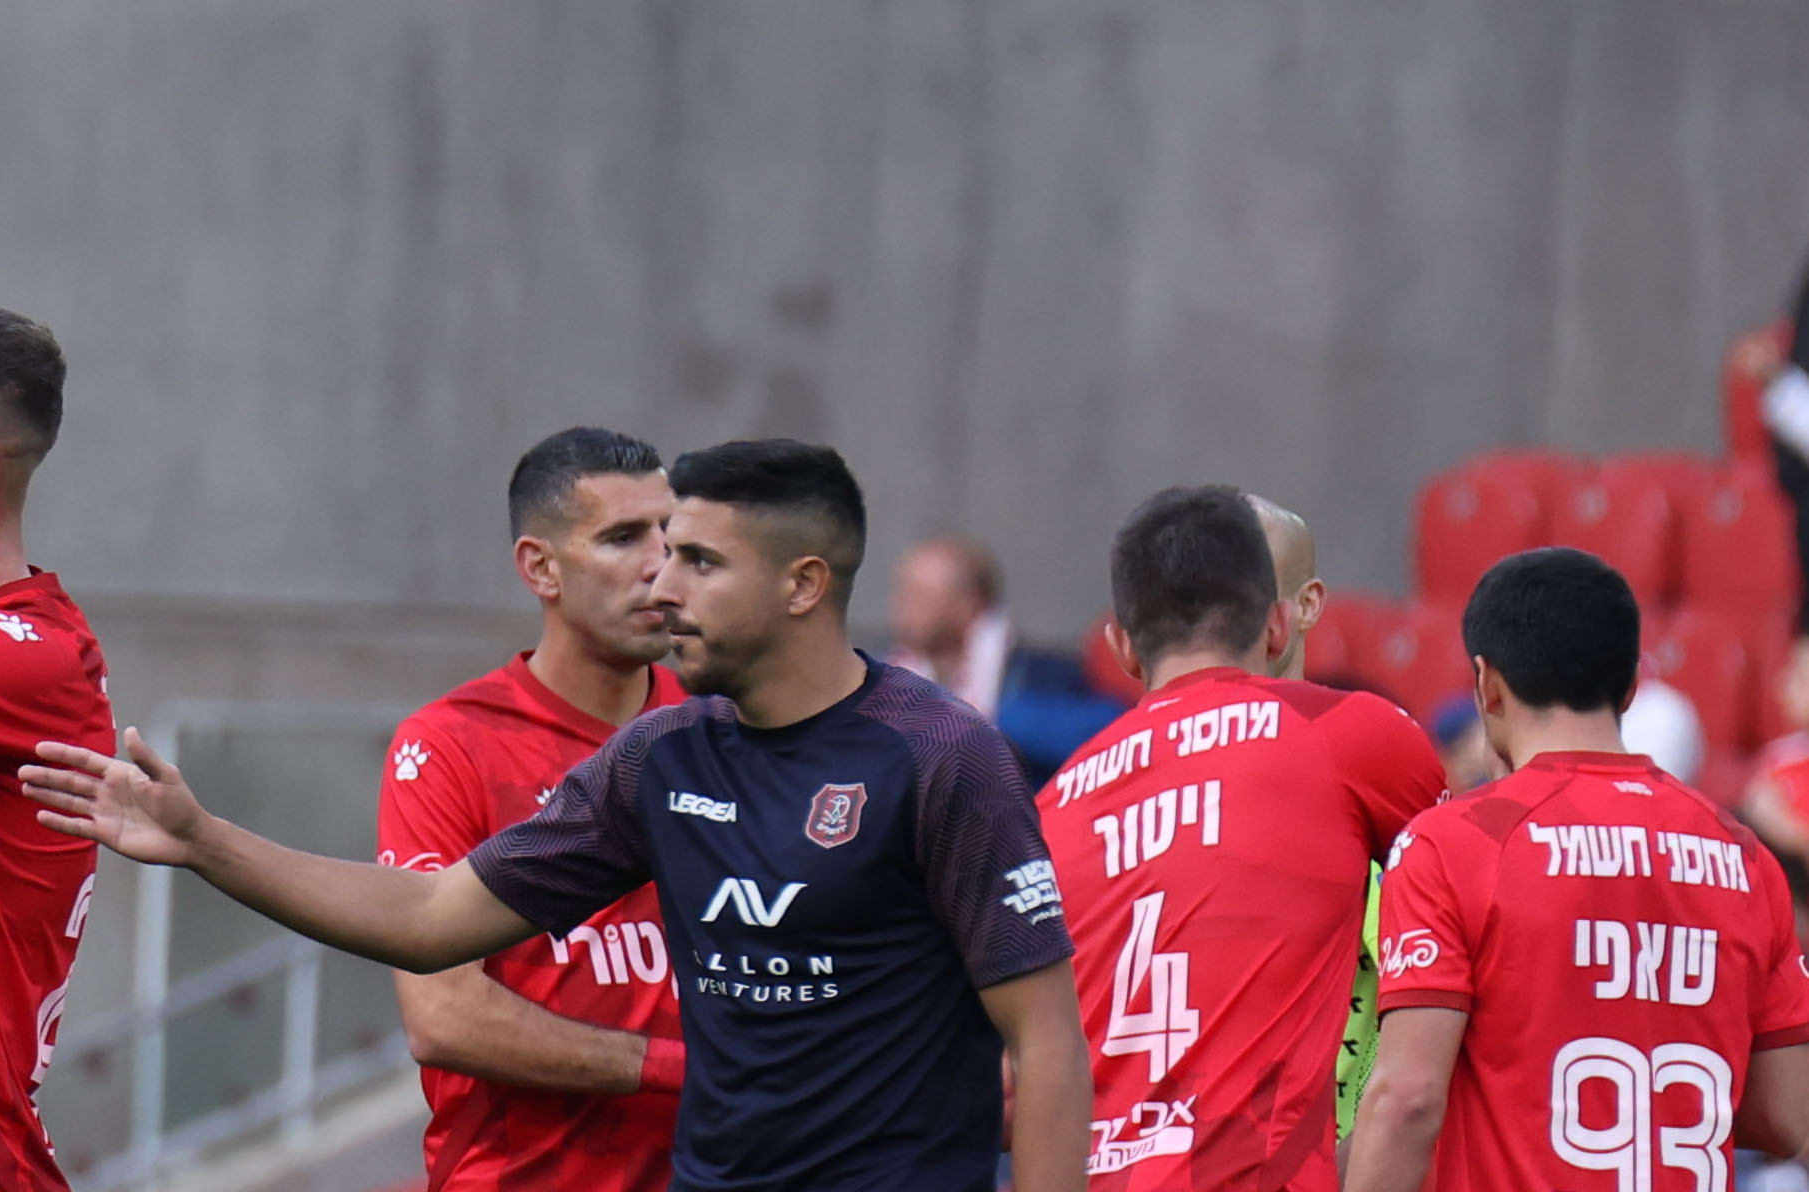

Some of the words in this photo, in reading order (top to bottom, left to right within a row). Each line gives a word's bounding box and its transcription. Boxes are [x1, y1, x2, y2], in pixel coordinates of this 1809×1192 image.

[1167, 700, 1281, 758] מחסני
[1055, 728, 1154, 809] חשמל
[669, 791, 738, 823] LEGEA
[1093, 779, 1222, 880] ויטור
[1527, 821, 1652, 879] חשמל
[1656, 830, 1751, 894] מחסני
[697, 976, 839, 1002] VENTURES
[1100, 891, 1200, 1084] 4
[1574, 918, 1719, 1007] שאפי
